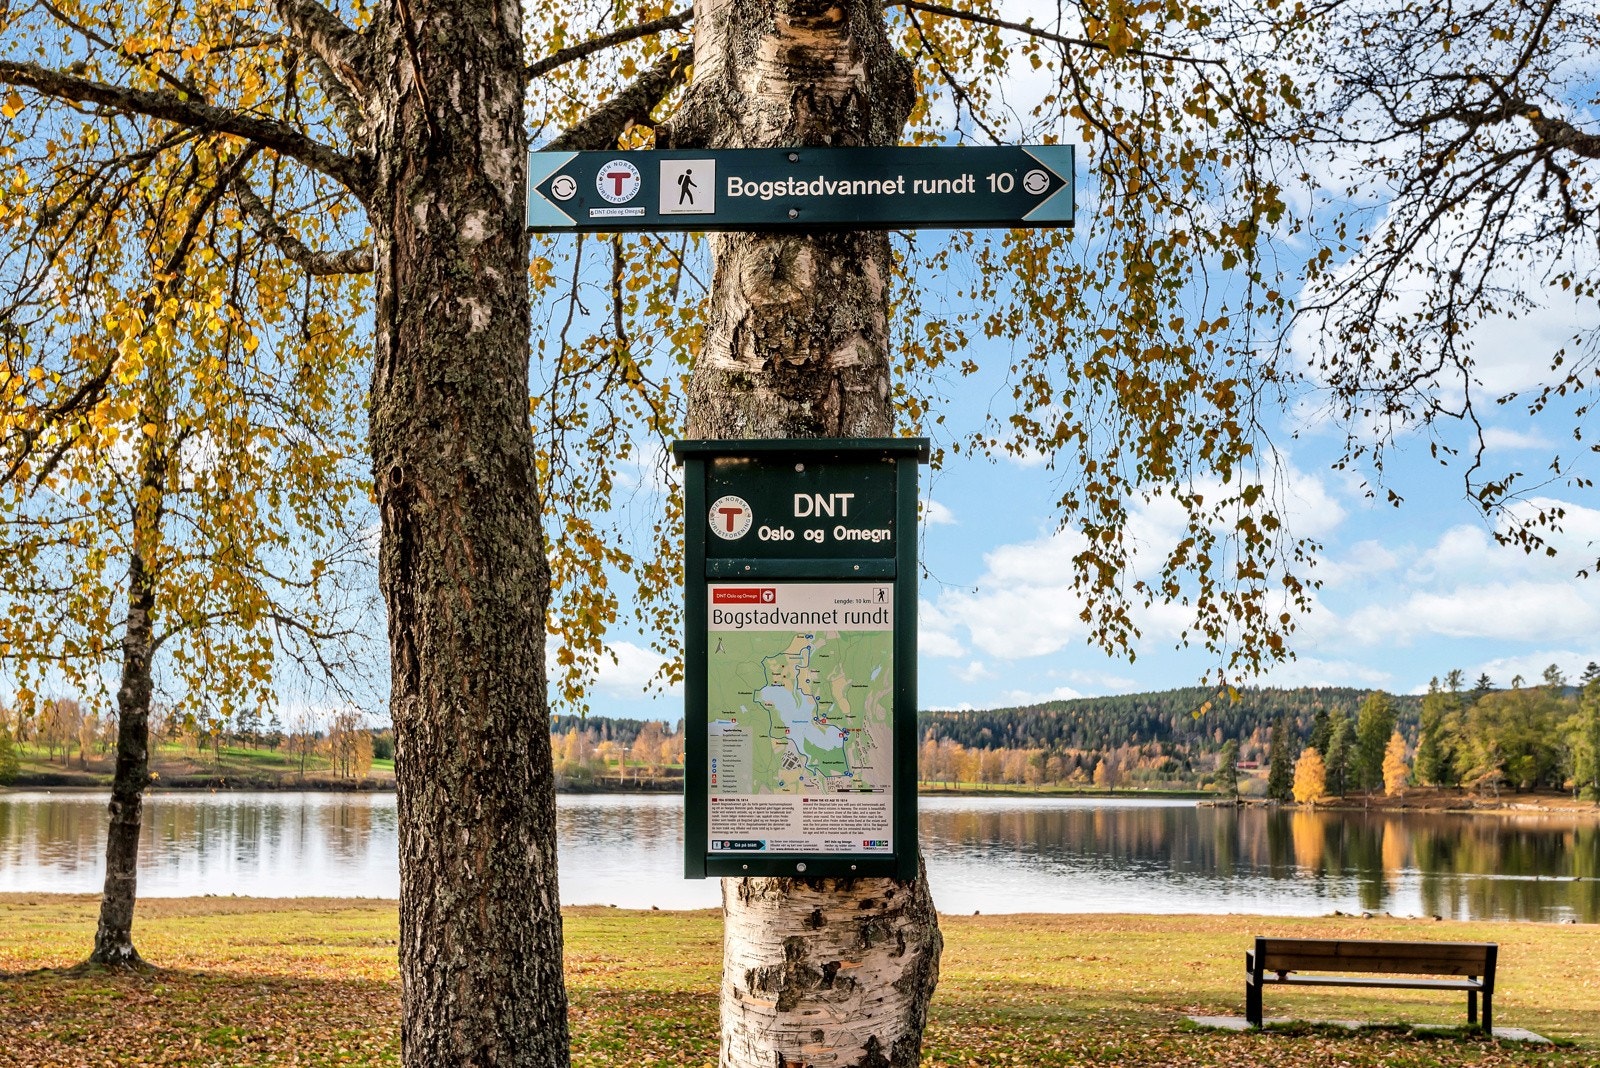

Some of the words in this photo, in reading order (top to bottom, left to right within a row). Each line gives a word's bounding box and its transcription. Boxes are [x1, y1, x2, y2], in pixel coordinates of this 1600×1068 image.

[600, 164, 612, 176] DEN
[614, 162, 638, 176] NORSKE
[598, 182, 639, 202] TURISTFORENING
[606, 172, 631, 196] T
[727, 176, 904, 200] Bogstadvannet
[914, 173, 975, 194] rundt
[986, 172, 1014, 192] 10
[712, 500, 723, 512] DEN
[725, 497, 750, 512] NORSKE
[794, 493, 854, 517] DNT
[710, 518, 750, 538] TURISTFORENING
[718, 508, 742, 532] T
[758, 525, 795, 541] Oslo
[804, 528, 824, 543] og
[833, 525, 891, 543] Omegn
[713, 608, 837, 628] Bogstadvannet
[844, 607, 889, 624] rundt
